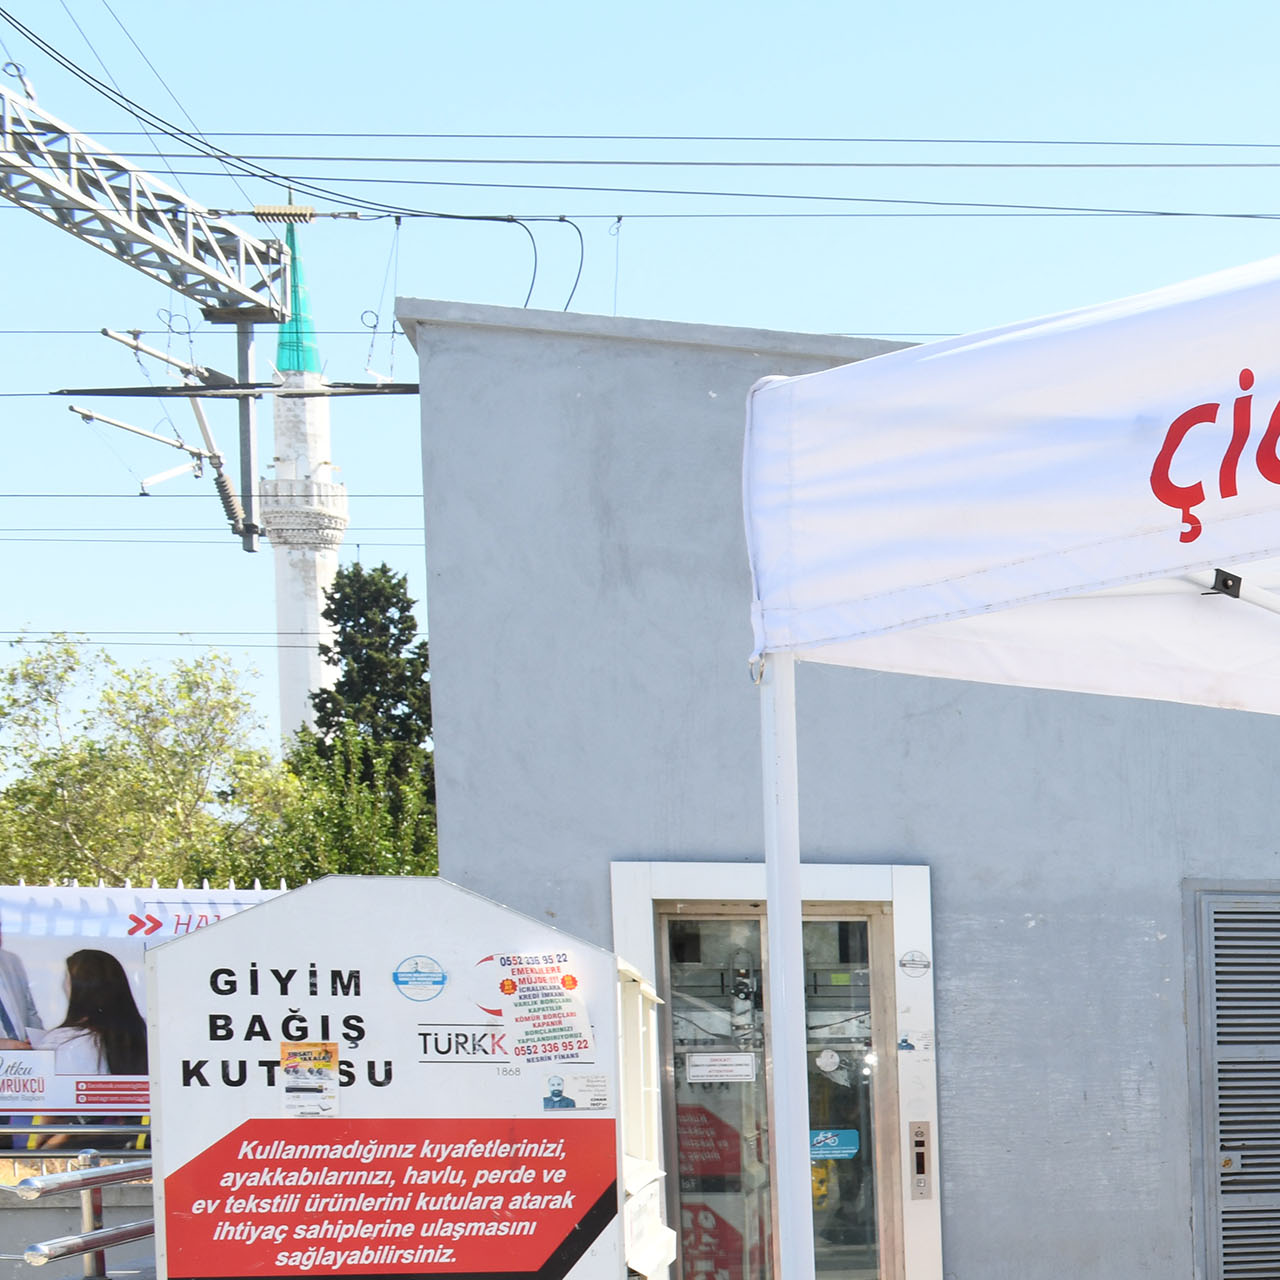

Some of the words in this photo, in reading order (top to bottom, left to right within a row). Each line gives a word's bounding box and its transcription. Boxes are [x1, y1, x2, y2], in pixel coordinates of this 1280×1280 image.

[500, 956, 523, 966] 0552
[542, 956, 553, 964] 95
[556, 954, 568, 963] 22
[210, 962, 361, 996] GİYİM
[209, 1008, 366, 1049] BAĞIŞ
[514, 1045, 538, 1056] 0552
[541, 1043, 559, 1053] 336
[562, 1042, 574, 1051] 95
[577, 1040, 589, 1049] 22
[182, 1060, 393, 1087] KUTSU
[496, 1067, 520, 1076] 1868
[237, 1140, 413, 1163] Kullanmadığınız
[420, 1139, 567, 1163] kıyafetlerinizi,
[219, 1166, 396, 1190] ayakkabılarınızı,
[402, 1165, 468, 1186] havlu,
[472, 1167, 537, 1188] perde
[542, 1169, 566, 1184] ve
[191, 1199, 221, 1214] ev
[225, 1194, 299, 1214] tekstili
[304, 1192, 412, 1213] ürünlerini
[415, 1193, 504, 1212] kutulara
[508, 1192, 576, 1210] atarak
[213, 1220, 288, 1245] ihtiyaç
[293, 1218, 414, 1242] sahiplerine
[420, 1218, 537, 1242] ulaşmasını
[274, 1247, 457, 1271] sağlayabilirsiniz.
